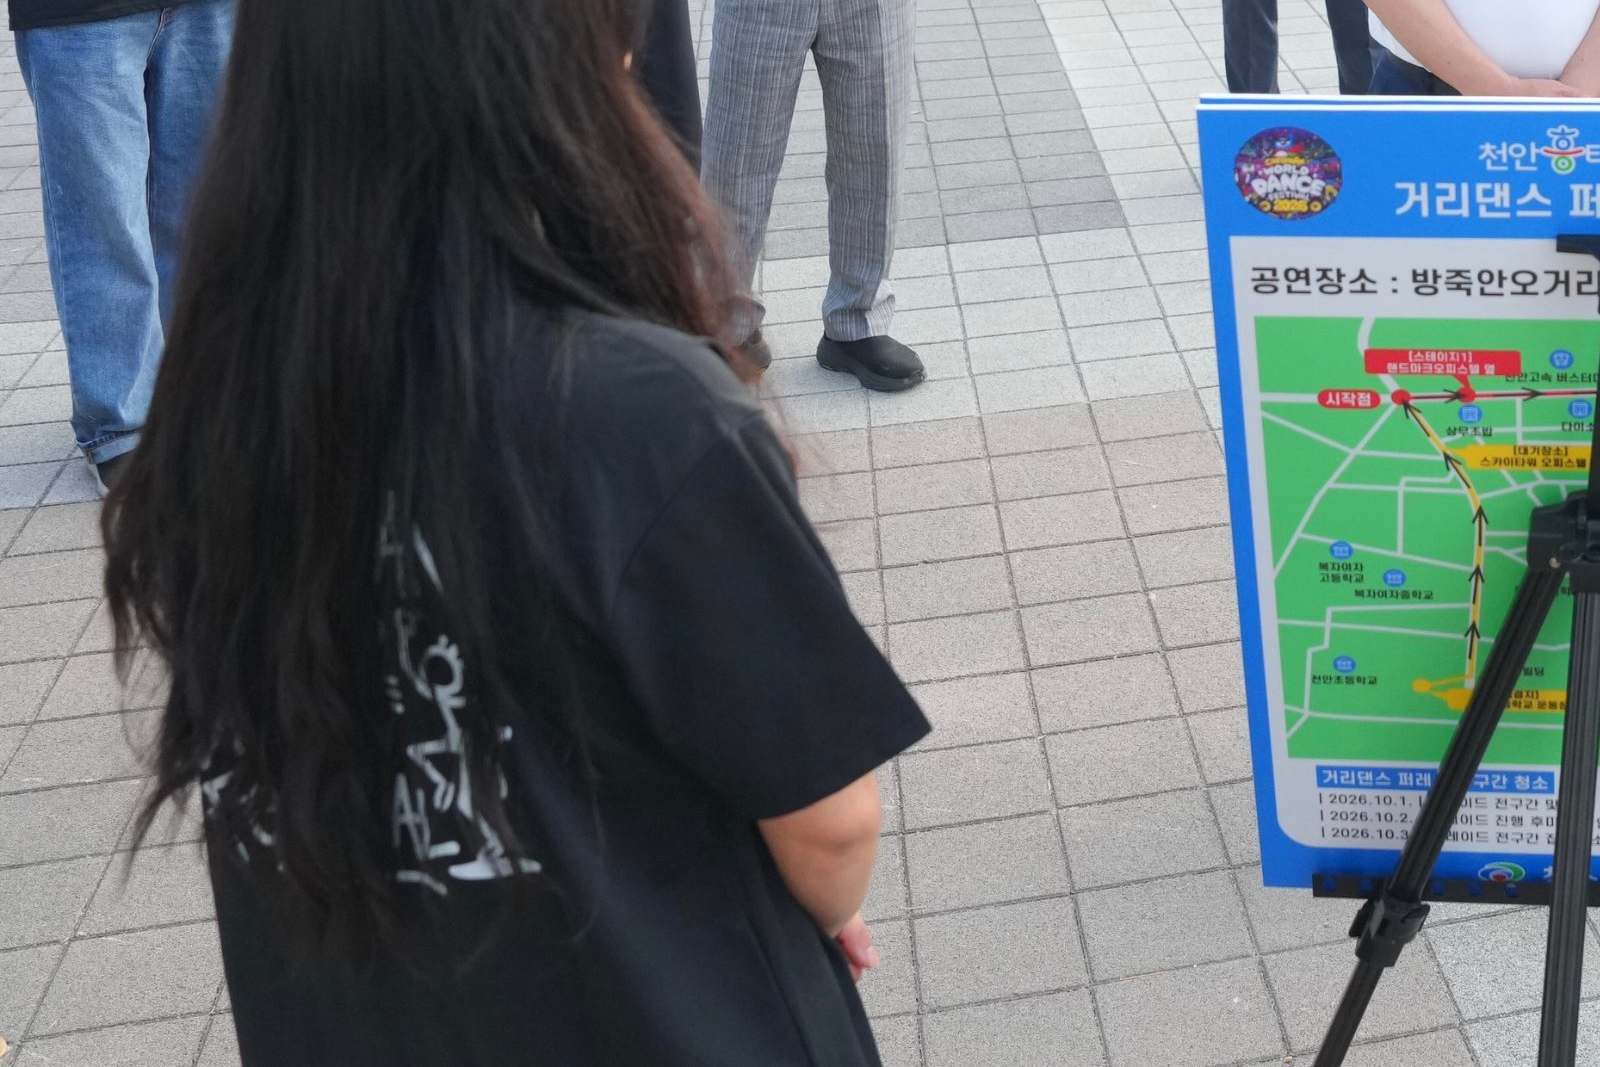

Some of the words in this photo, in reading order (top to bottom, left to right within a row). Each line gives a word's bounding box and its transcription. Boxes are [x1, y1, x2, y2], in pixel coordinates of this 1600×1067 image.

[1263, 164, 1309, 176] WORLD
[1251, 174, 1326, 198] DANCE
[1394, 182, 1552, 220] 거리댄스
[1250, 267, 1379, 296] 공연장소
[1408, 350, 1473, 363] [스테이지1]
[1386, 362, 1481, 374] 랜드마크오피스텔
[1556, 371, 1598, 383] 버스터
[1325, 390, 1372, 407] 시작점
[1513, 445, 1568, 457] [대기장소]
[1480, 457, 1537, 468] 스카이타워
[1541, 457, 1587, 468] 오피스텔
[1319, 572, 1364, 583] 고등학교
[1322, 769, 1391, 786] 거리댄스
[1398, 772, 1432, 787] 퍼레
[1513, 774, 1548, 791] 청소
[1328, 794, 1412, 807] 2026.10.1.
[1462, 797, 1488, 810] 이드
[1495, 797, 1539, 811] 전구간
[1329, 810, 1413, 823] 2026.10.2.
[1496, 814, 1524, 828] 진행
[1330, 827, 1409, 840] 2026.10.3
[1446, 831, 1488, 844] 레이드
[1496, 832, 1539, 845] 전구간
